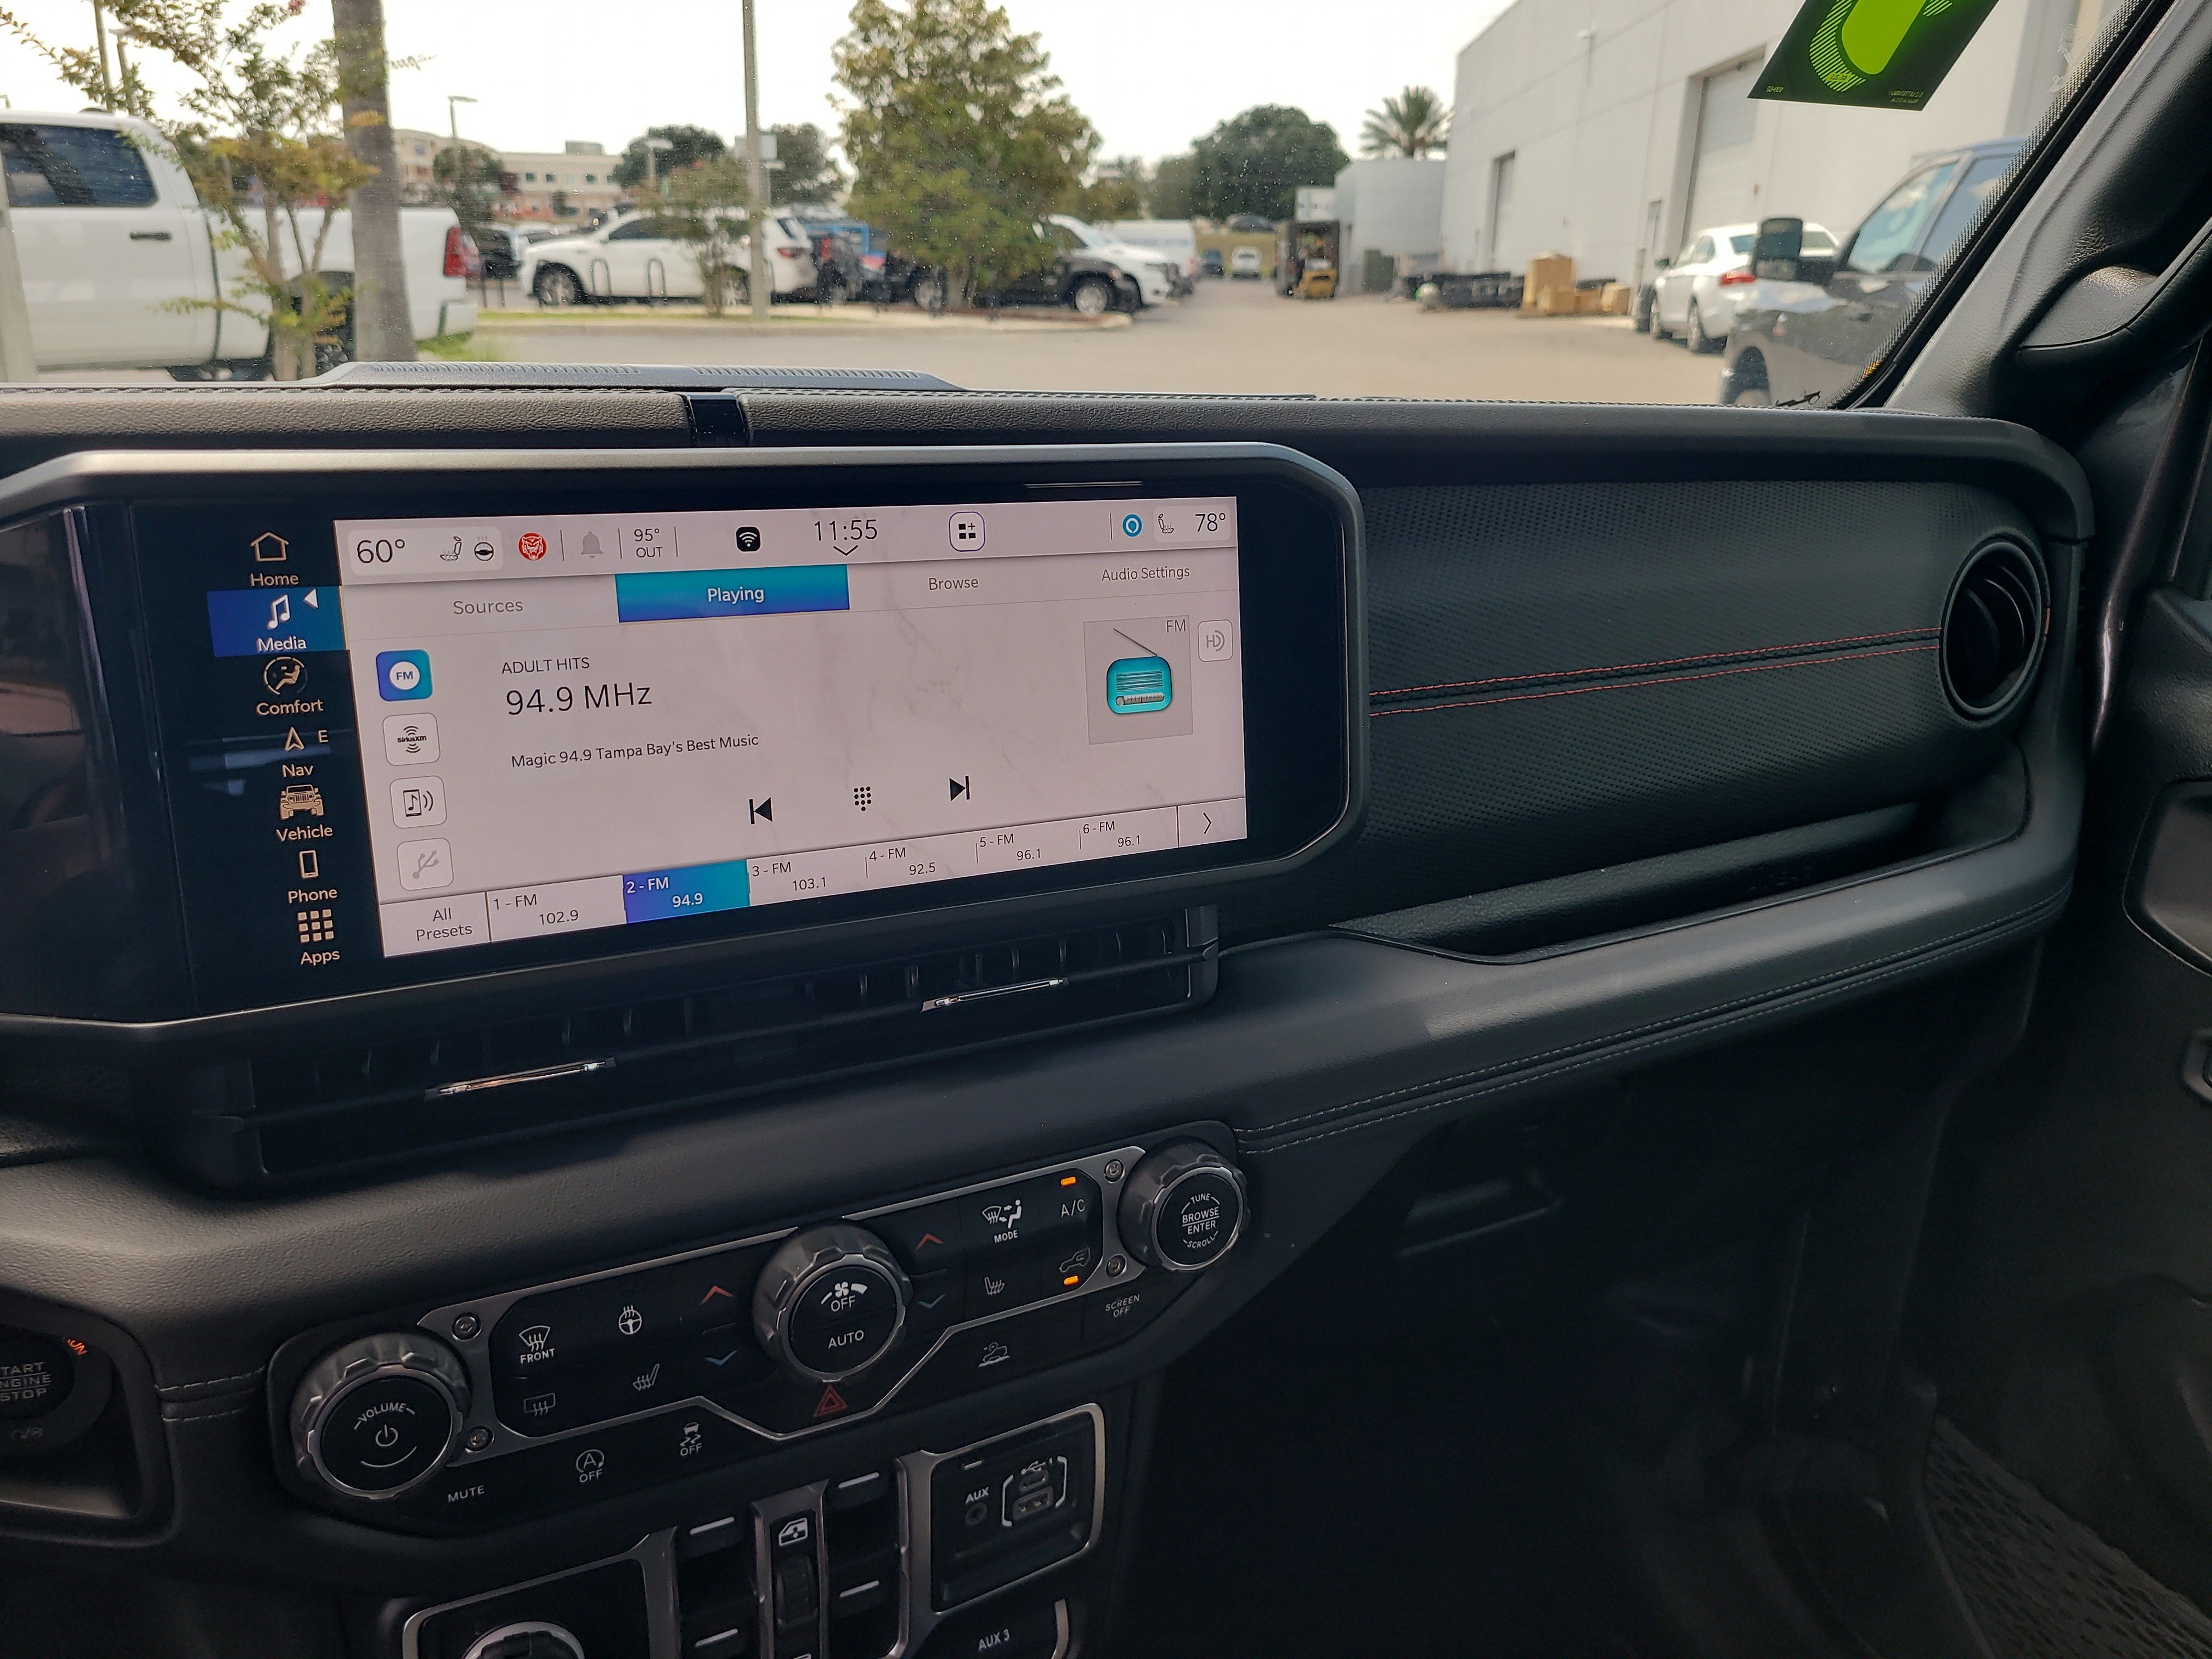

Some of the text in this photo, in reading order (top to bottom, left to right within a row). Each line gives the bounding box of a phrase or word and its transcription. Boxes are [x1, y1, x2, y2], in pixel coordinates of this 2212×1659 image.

[634, 528, 660, 541] 95°
[814, 519, 878, 541] 11:55
[636, 546, 663, 558] OUT
[250, 572, 299, 586] Home
[1102, 566, 1190, 582] Audio Settings
[929, 576, 979, 590] Browse
[707, 588, 764, 605] Playing
[453, 599, 523, 615] Sources
[1166, 619, 1186, 633] FM
[256, 637, 307, 651] Media
[501, 657, 590, 674] ADULT HITS
[397, 670, 414, 681] FM
[256, 699, 324, 715] Comfort
[506, 684, 652, 715] 94.9 MHz
[318, 730, 329, 743] E
[512, 733, 759, 769] Magic 94.9 Tampa Bay's Best Music
[281, 763, 314, 777] Nav
[276, 825, 333, 842] Vehicle
[1082, 823, 1090, 834] 6
[1099, 820, 1115, 832] FM
[979, 836, 986, 847] 5
[997, 832, 1014, 845] FM
[1118, 834, 1141, 847] 96.1
[869, 850, 877, 862] 4
[887, 847, 906, 860] FM
[1017, 849, 1042, 861] 96.1
[752, 866, 760, 877] 3
[772, 861, 792, 874] FM
[909, 862, 936, 876] 92.5
[627, 881, 636, 894] 2
[648, 877, 669, 891] FM
[792, 877, 827, 891] 103.1
[287, 887, 338, 902] Phone
[494, 899, 501, 910] 1
[515, 894, 538, 907] FM
[672, 894, 703, 909] 94.9
[433, 909, 452, 921] All
[539, 910, 579, 926] 102.9
[416, 923, 472, 941] Presets
[300, 949, 340, 965] Apps
[1190, 1193, 1211, 1204] TUNE
[1060, 1199, 1085, 1219] A/C
[1182, 1207, 1220, 1223] BROWSE
[1187, 1220, 1217, 1234] ENTER
[994, 1229, 1019, 1244] MODE
[1187, 1235, 1215, 1248] SCROLL
[830, 1295, 855, 1312] OFF
[1105, 1294, 1140, 1312] SCREEN
[1113, 1306, 1131, 1317] OFF
[828, 1329, 865, 1348] AUTO
[64, 1338, 88, 1356] UN
[520, 1348, 556, 1364] FRONT
[0, 1362, 44, 1374] TART
[0, 1374, 52, 1389] NGINE
[0, 1388, 47, 1401] STOP
[358, 1402, 406, 1423] VOLUME
[680, 1443, 702, 1456] OFF
[579, 1469, 603, 1483] OFF
[447, 1485, 485, 1503] MUTE
[965, 1486, 989, 1504] AUX
[978, 1628, 1010, 1651] AUX 3
